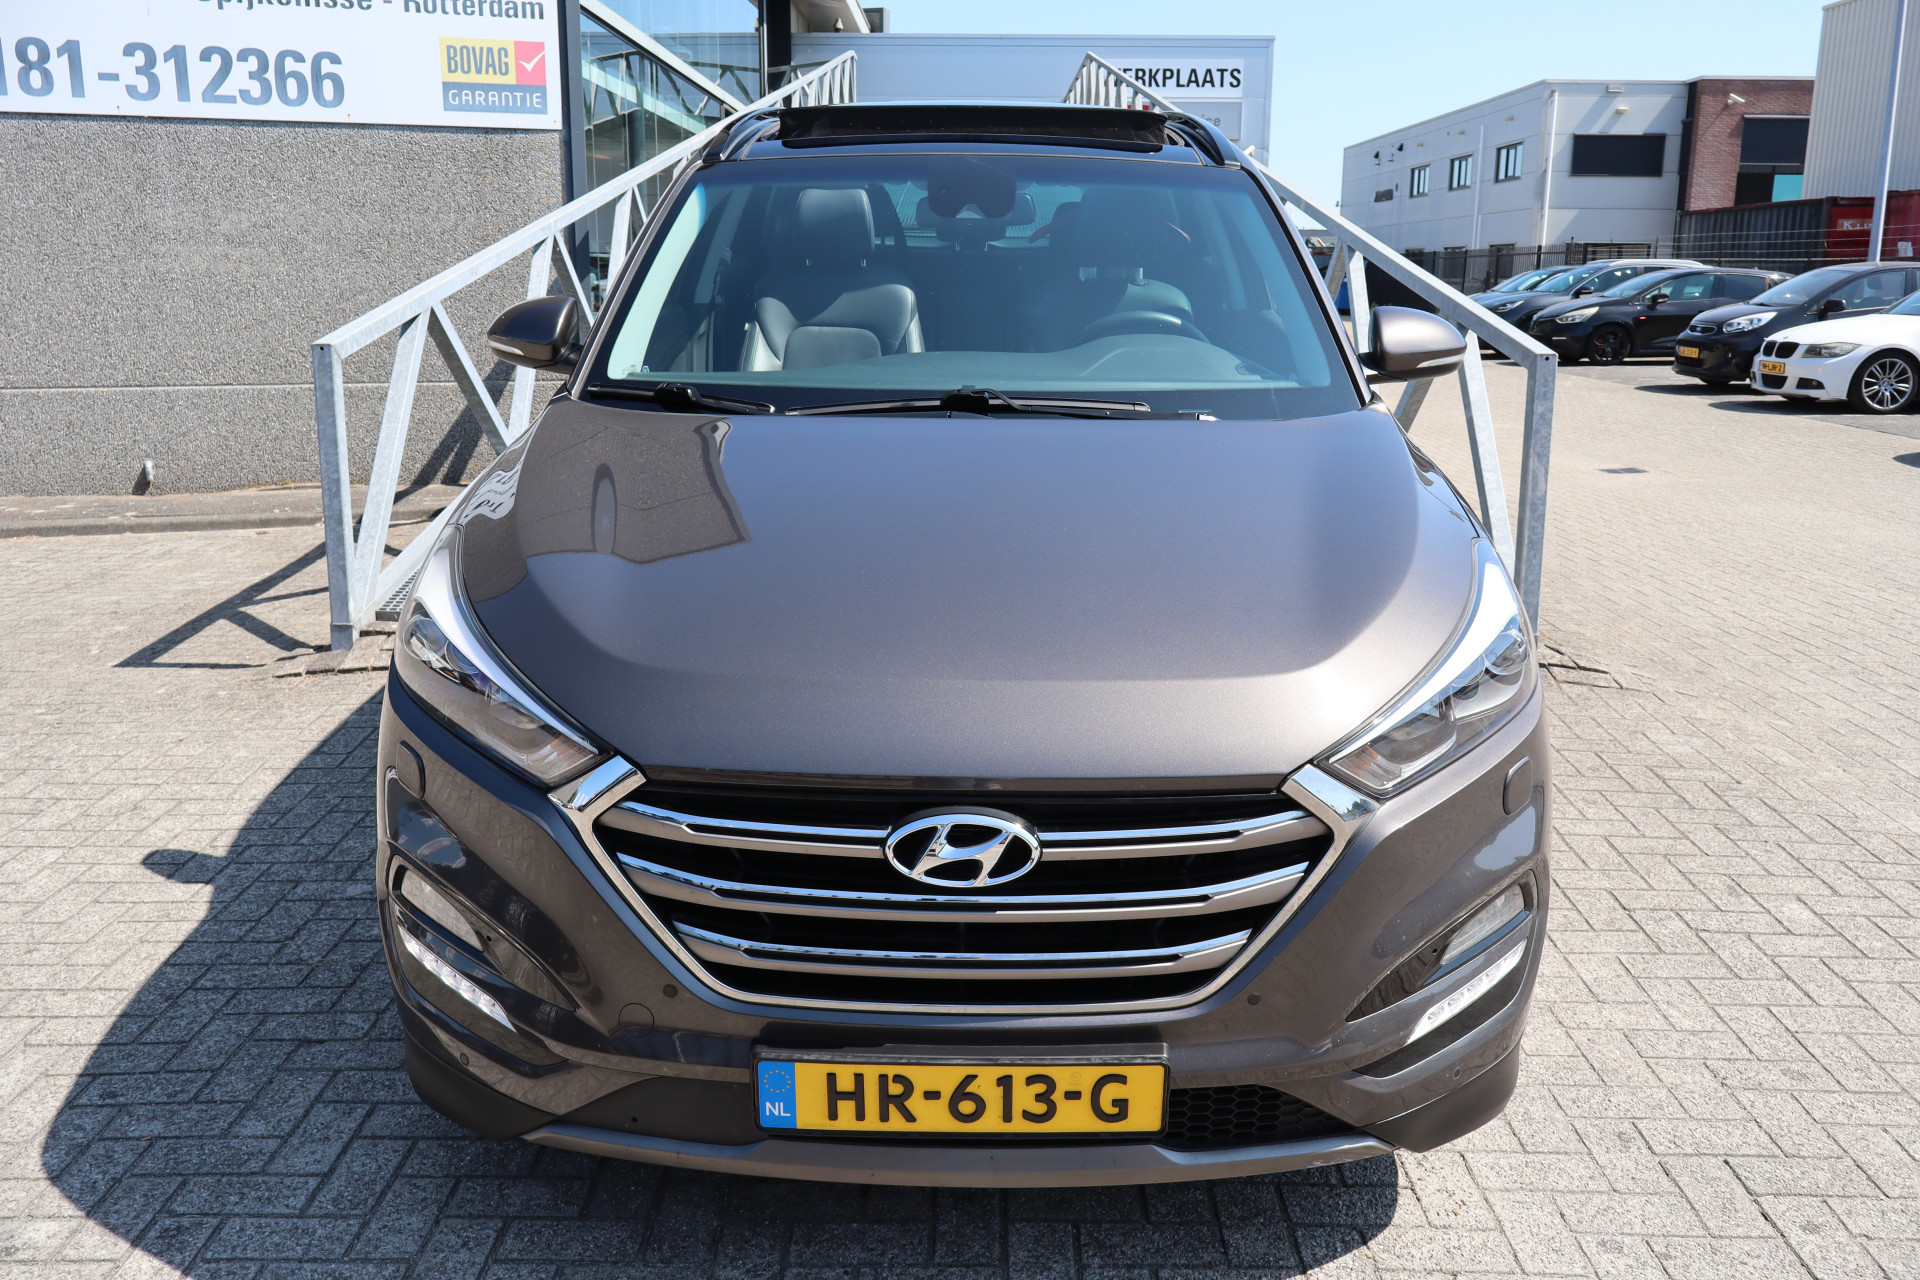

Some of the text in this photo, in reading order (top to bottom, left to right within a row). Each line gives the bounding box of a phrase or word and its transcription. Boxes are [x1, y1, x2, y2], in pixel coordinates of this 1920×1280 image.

[446, 44, 510, 77] BOVAG
[1104, 67, 1242, 88] RKPLAATS
[448, 90, 543, 108] GARANTIE
[826, 1073, 1129, 1124] HR-613-G
[765, 1102, 791, 1117] NL
